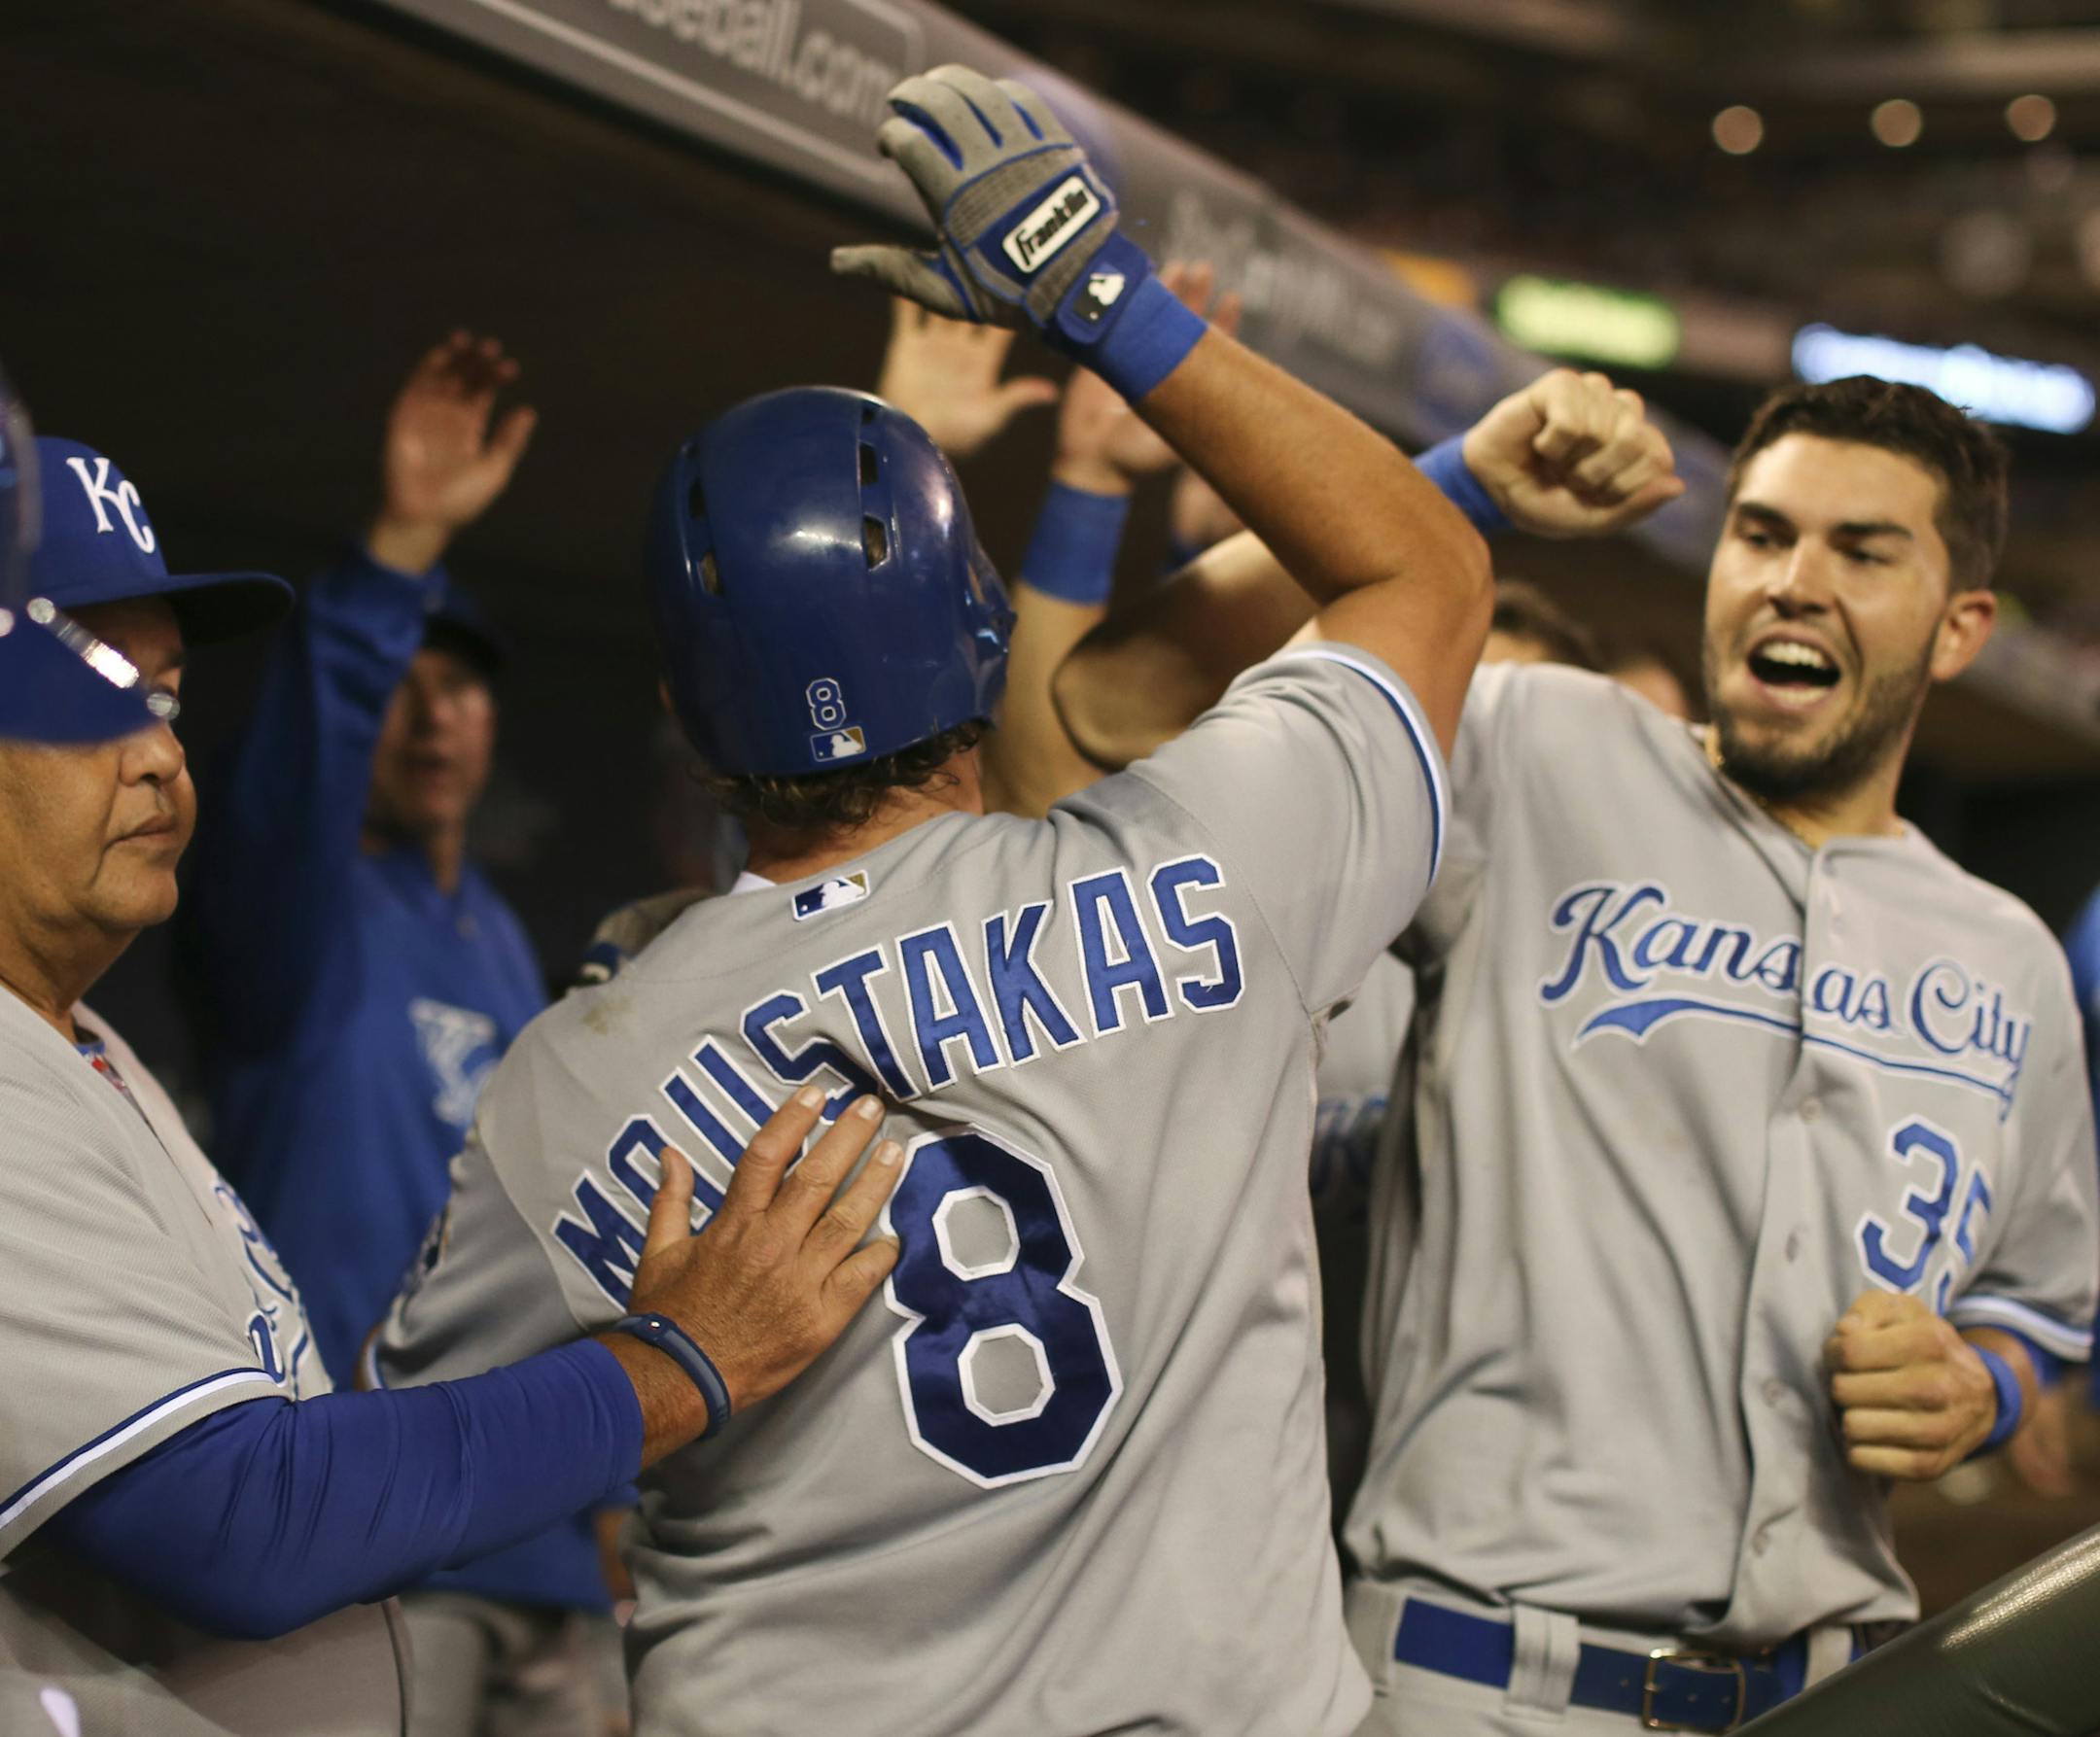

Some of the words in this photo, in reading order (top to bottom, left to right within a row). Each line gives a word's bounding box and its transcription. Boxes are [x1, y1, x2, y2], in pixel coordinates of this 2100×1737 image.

[65, 456, 156, 554] KC
[805, 677, 847, 731] 8
[550, 852, 1245, 1314] MOUSTAKAS
[1539, 879, 1894, 1034] Kansas
[1908, 958, 2034, 1124] City
[881, 1124, 1125, 1491] 8
